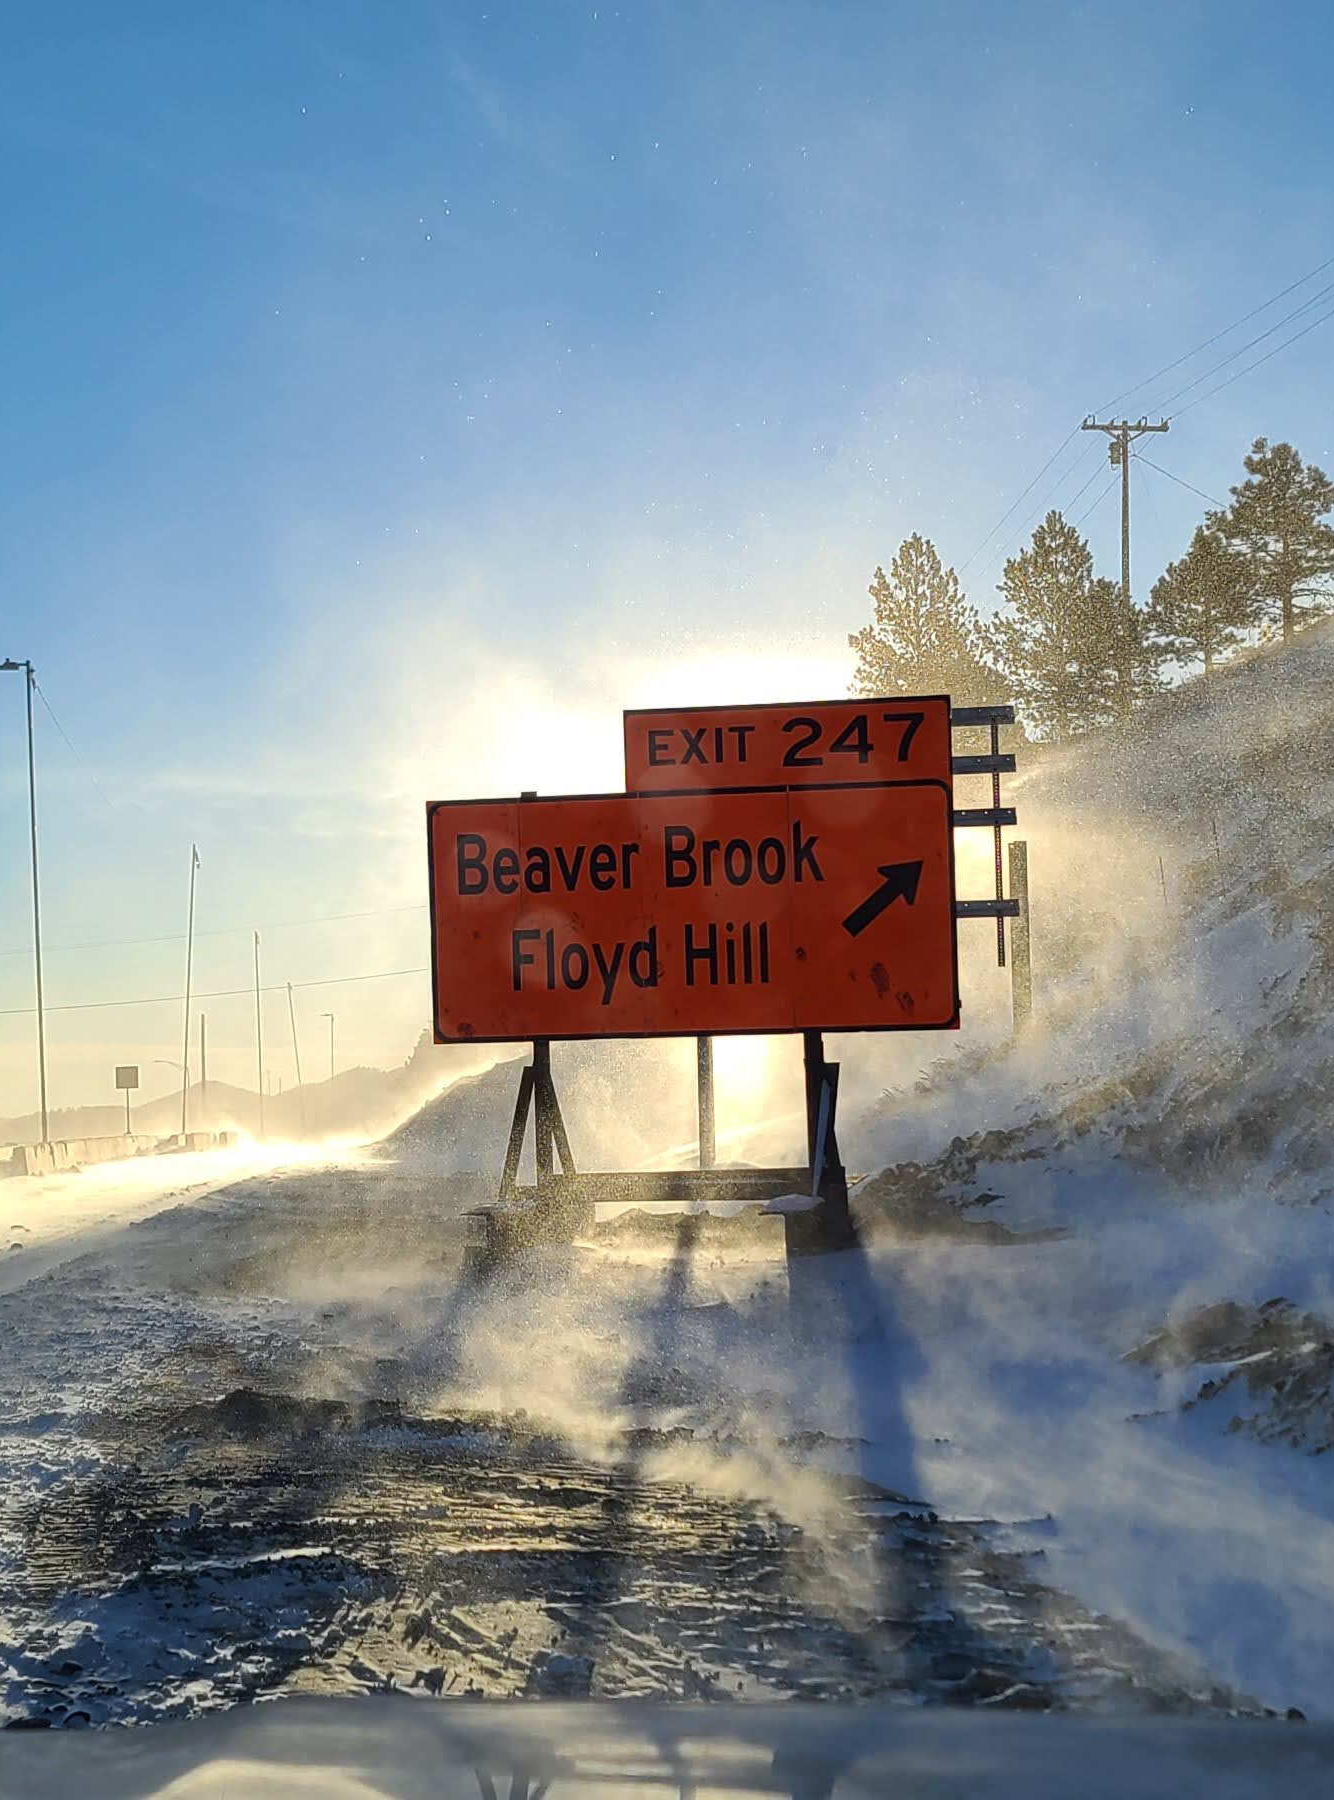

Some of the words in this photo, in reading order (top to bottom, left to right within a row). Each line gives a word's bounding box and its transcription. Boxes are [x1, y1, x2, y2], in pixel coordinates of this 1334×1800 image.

[648, 726, 755, 767] EXIT
[781, 712, 925, 767] 247
[456, 833, 640, 895] Beaver
[664, 821, 824, 888] Brook
[511, 925, 658, 1005] Floyd
[684, 922, 769, 986] Hill
